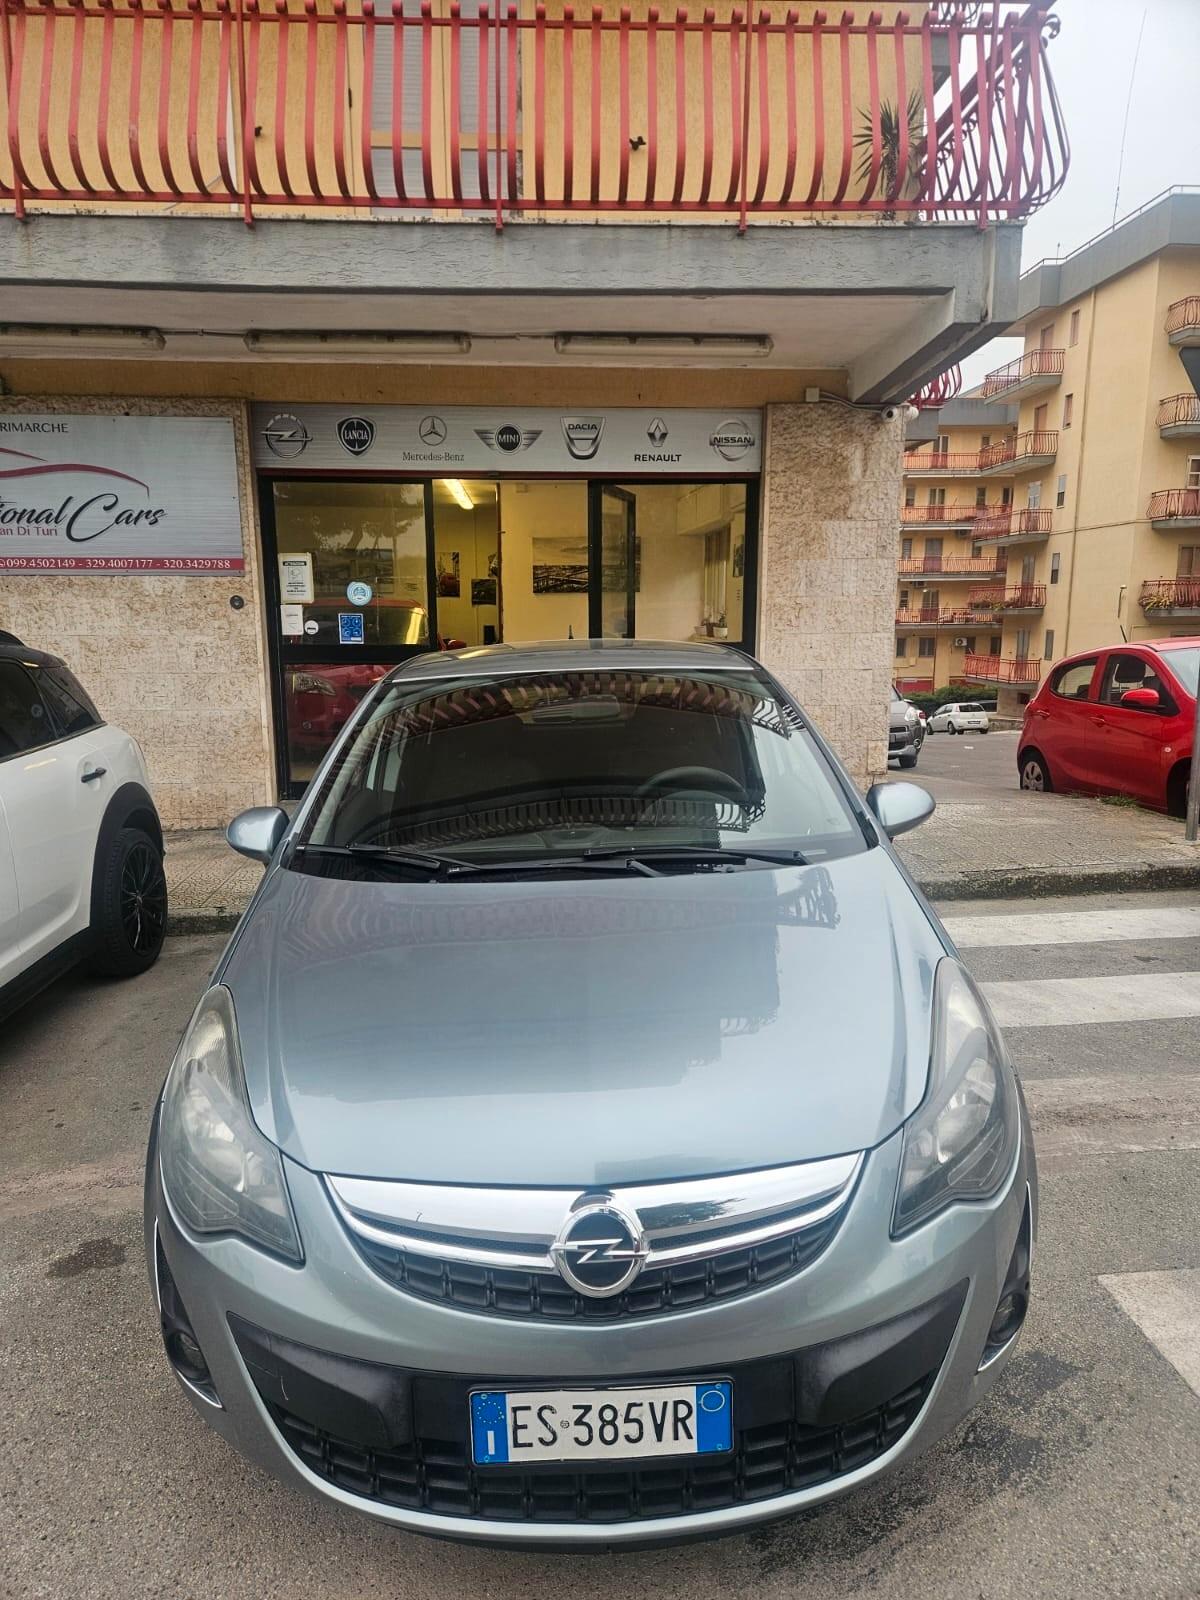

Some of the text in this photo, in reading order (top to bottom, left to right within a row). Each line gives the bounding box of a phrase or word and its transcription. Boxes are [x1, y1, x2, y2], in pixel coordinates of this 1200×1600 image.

[567, 423, 598, 431] DACIA
[343, 430, 368, 441] LANCIA
[497, 433, 519, 444] MINI
[713, 436, 751, 444] NISSAN
[402, 451, 465, 462] Mercedes-Benz
[634, 454, 682, 462] RENAULT
[66, 493, 167, 543] Cars
[17, 526, 30, 536] Di
[33, 526, 58, 536] Turi
[6, 558, 75, 568] 099.4502149
[86, 558, 153, 568] 329.4007177
[164, 559, 231, 569] 320.3429788
[511, 1399, 695, 1448] ES 385VR
